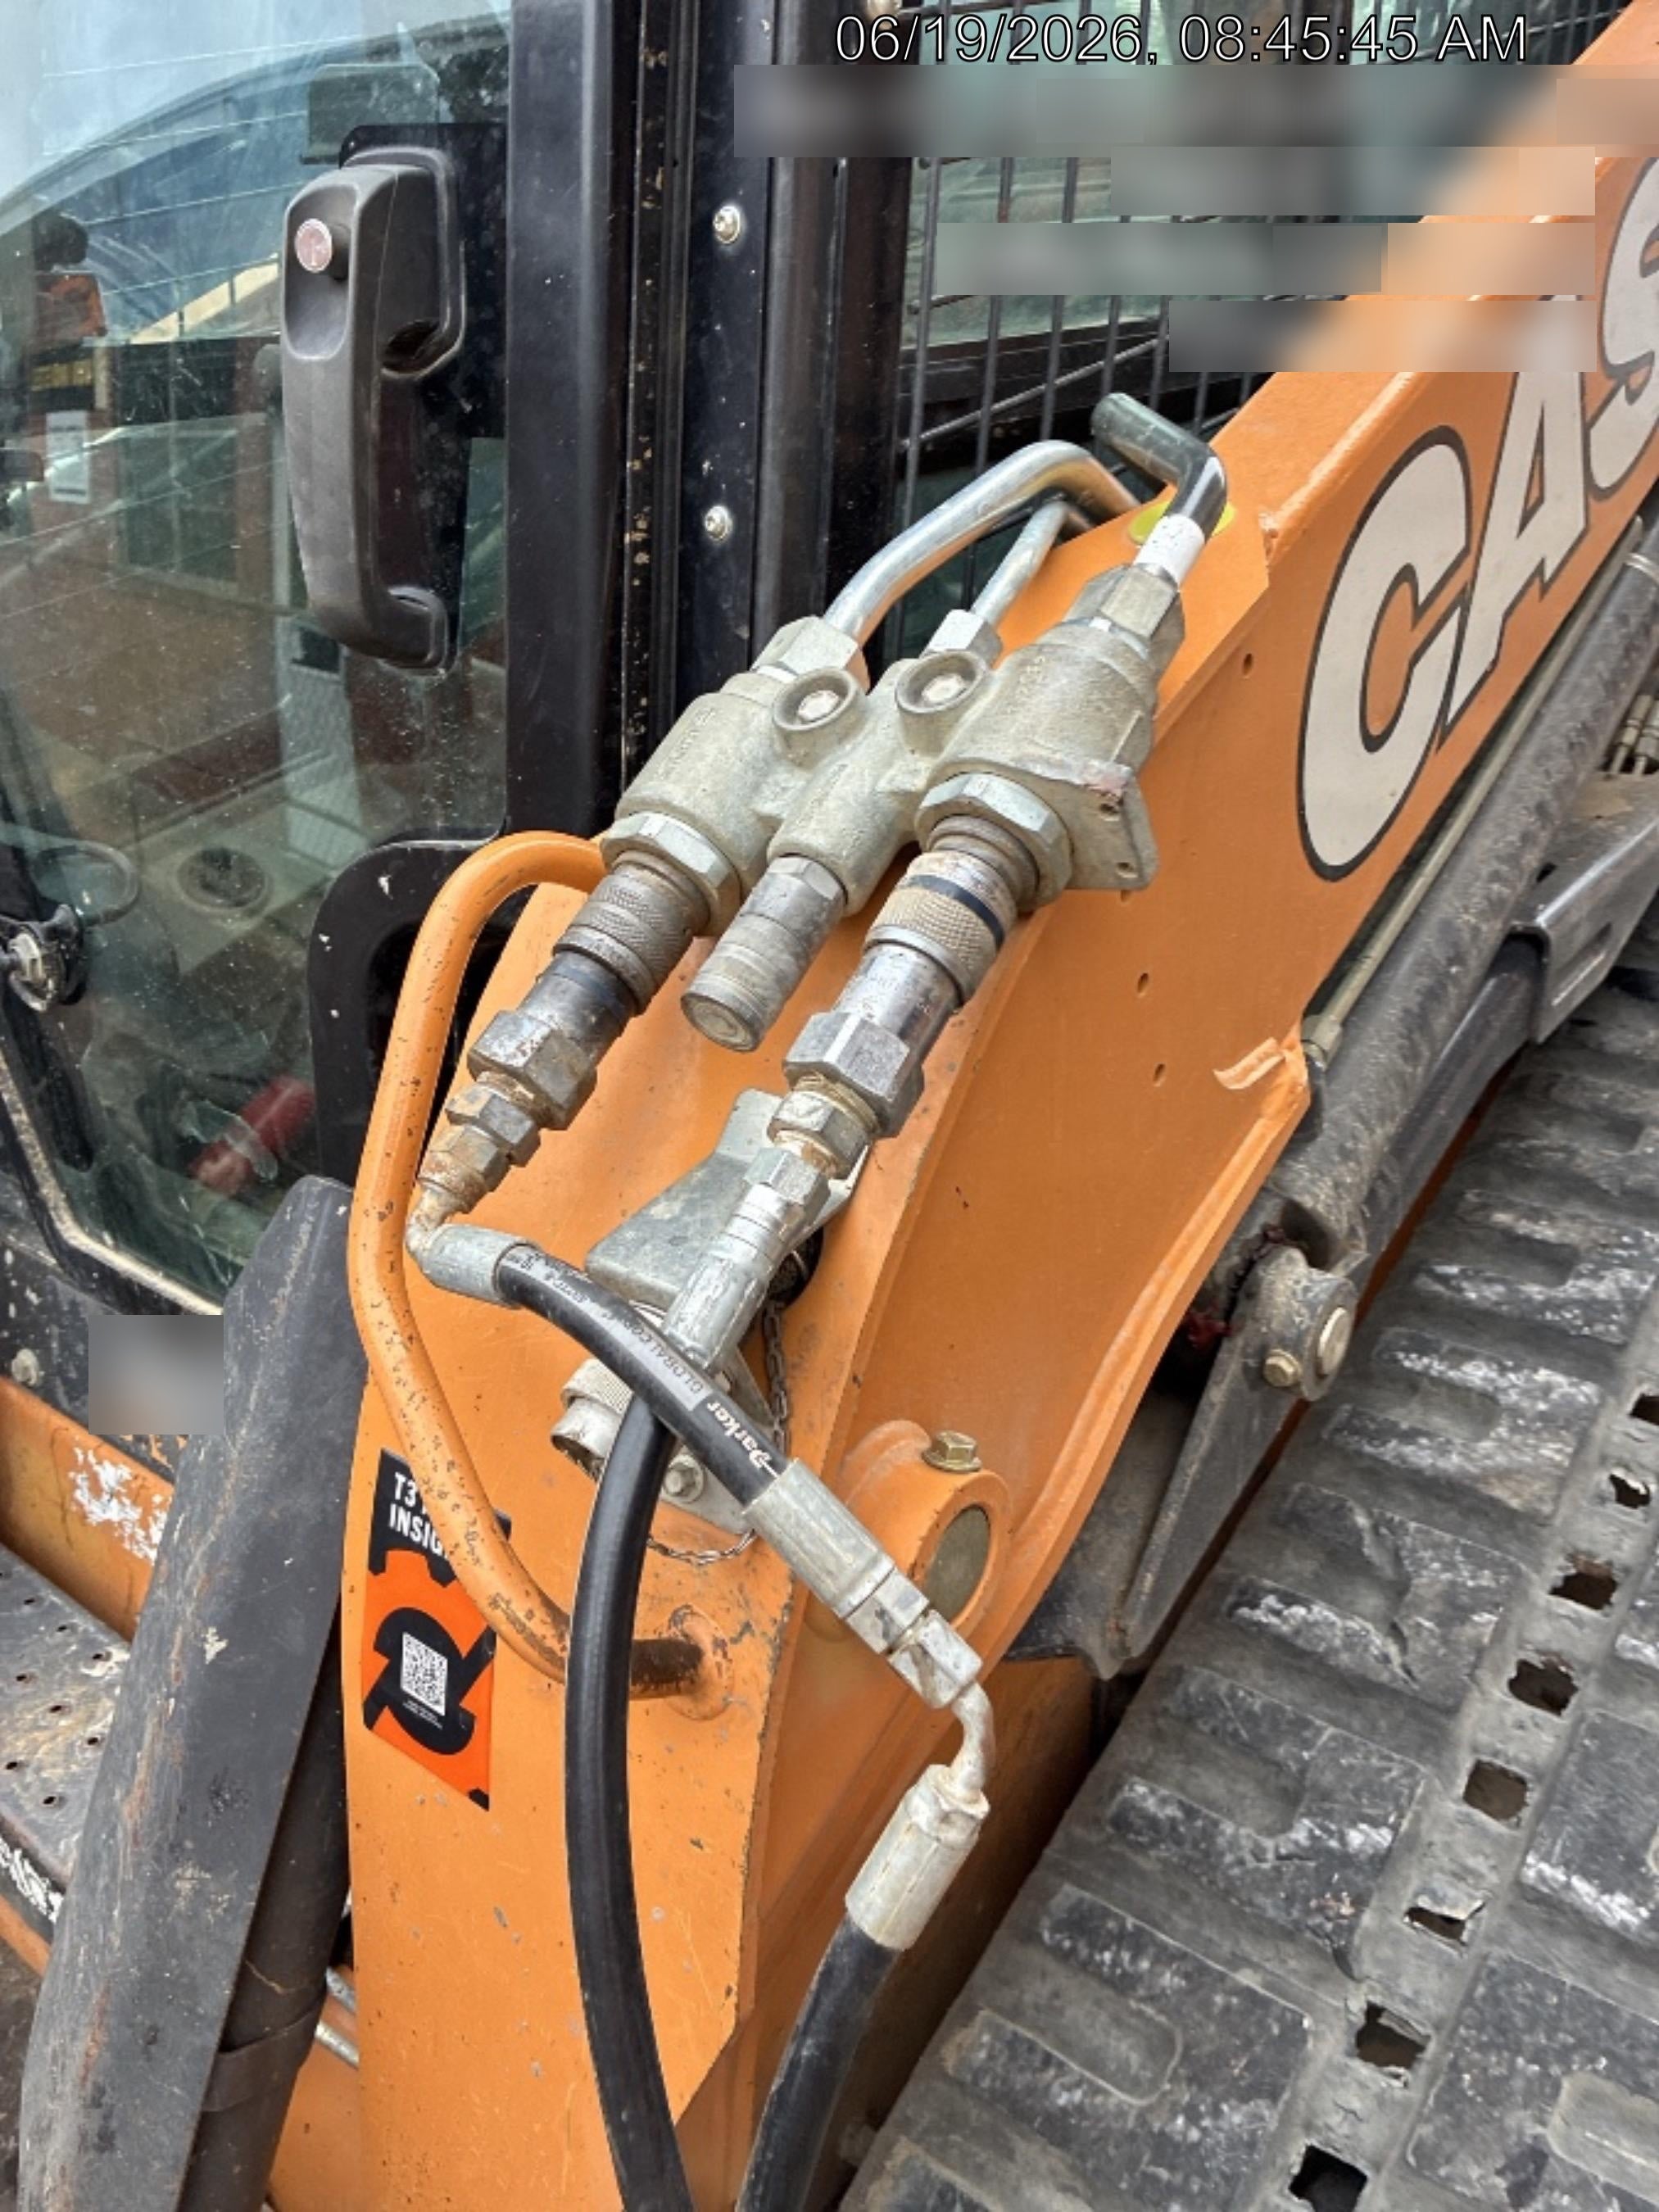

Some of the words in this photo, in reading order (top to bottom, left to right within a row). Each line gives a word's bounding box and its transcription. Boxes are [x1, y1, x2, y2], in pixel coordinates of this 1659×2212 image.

[706, 1400, 780, 1480] Parker
[394, 1471, 416, 1507] T3
[389, 1503, 448, 1559] INSIG
